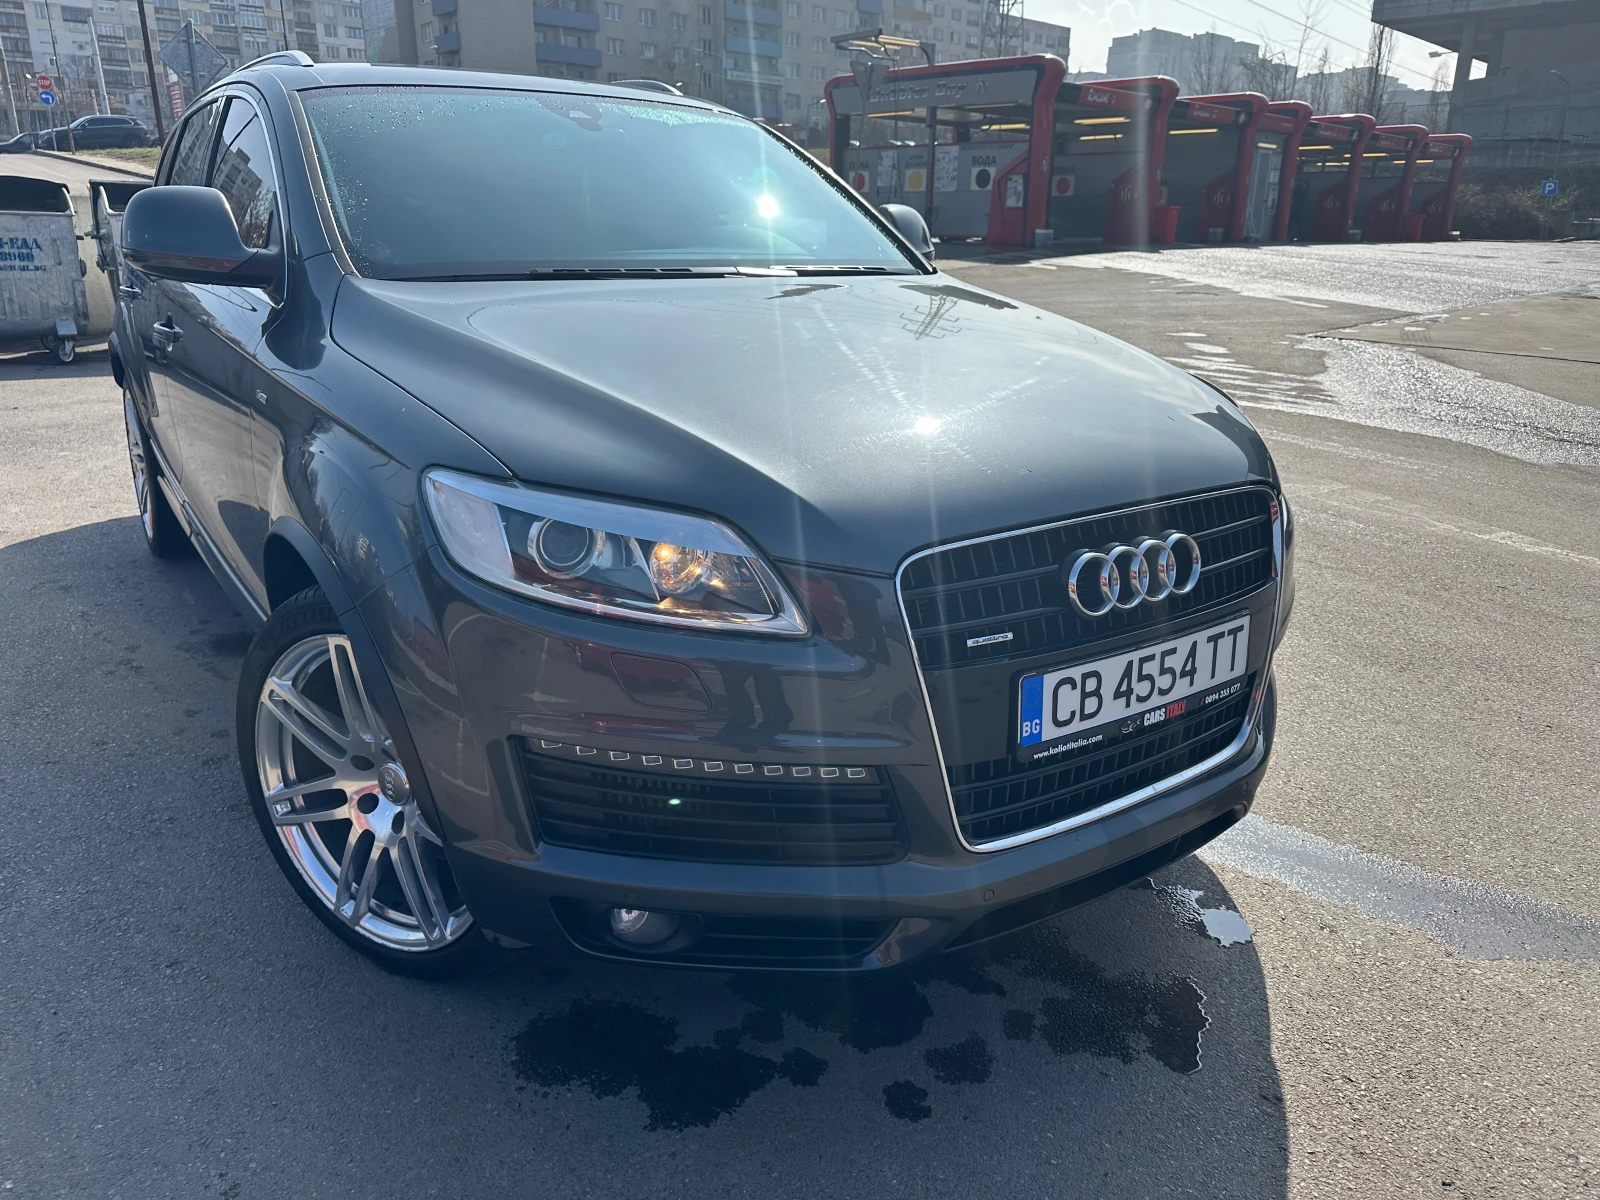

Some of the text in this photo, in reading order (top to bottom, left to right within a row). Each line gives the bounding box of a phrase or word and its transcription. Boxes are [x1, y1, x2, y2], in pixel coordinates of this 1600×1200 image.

[934, 80, 967, 99] Bay
[971, 156, 997, 167] ВОДА
[1545, 182, 1555, 194] P
[971, 634, 1009, 645] quattro
[1051, 624, 1245, 728] CB 4554 TT
[1205, 692, 1219, 704] 0894
[1230, 683, 1241, 694] 077
[1143, 700, 1187, 726] CARS ITALY
[1022, 719, 1041, 738] BG
